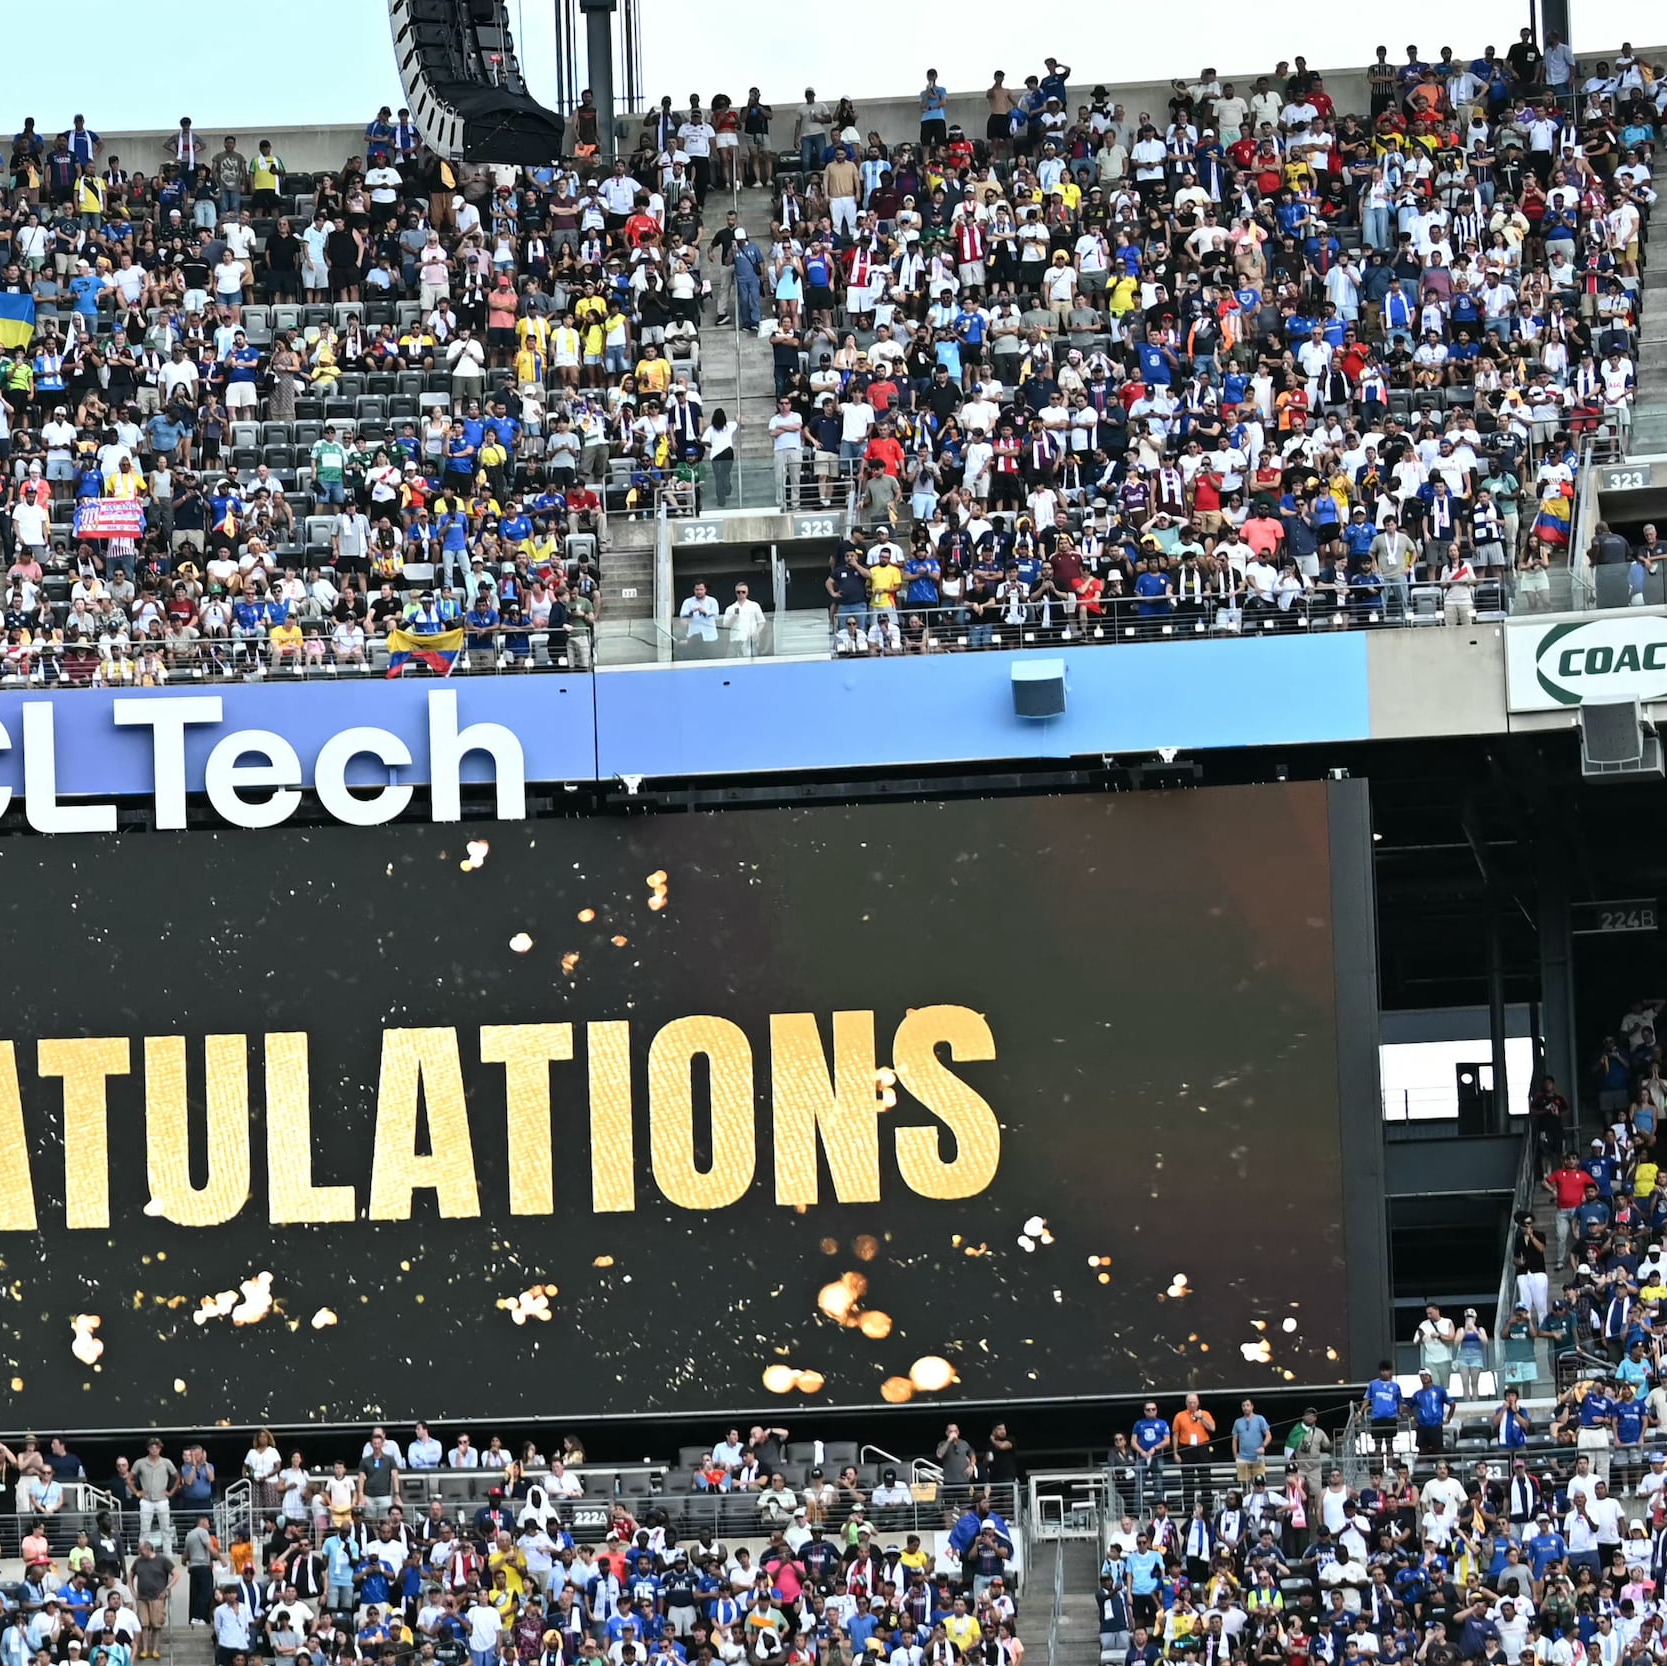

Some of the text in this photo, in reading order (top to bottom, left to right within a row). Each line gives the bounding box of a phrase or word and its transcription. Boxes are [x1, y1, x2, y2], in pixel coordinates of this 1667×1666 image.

[1610, 471, 1643, 489] 323
[684, 524, 717, 543] 322
[800, 519, 834, 537] 323
[1600, 909, 1654, 930] 224B
[574, 1511, 608, 1525] 222A
